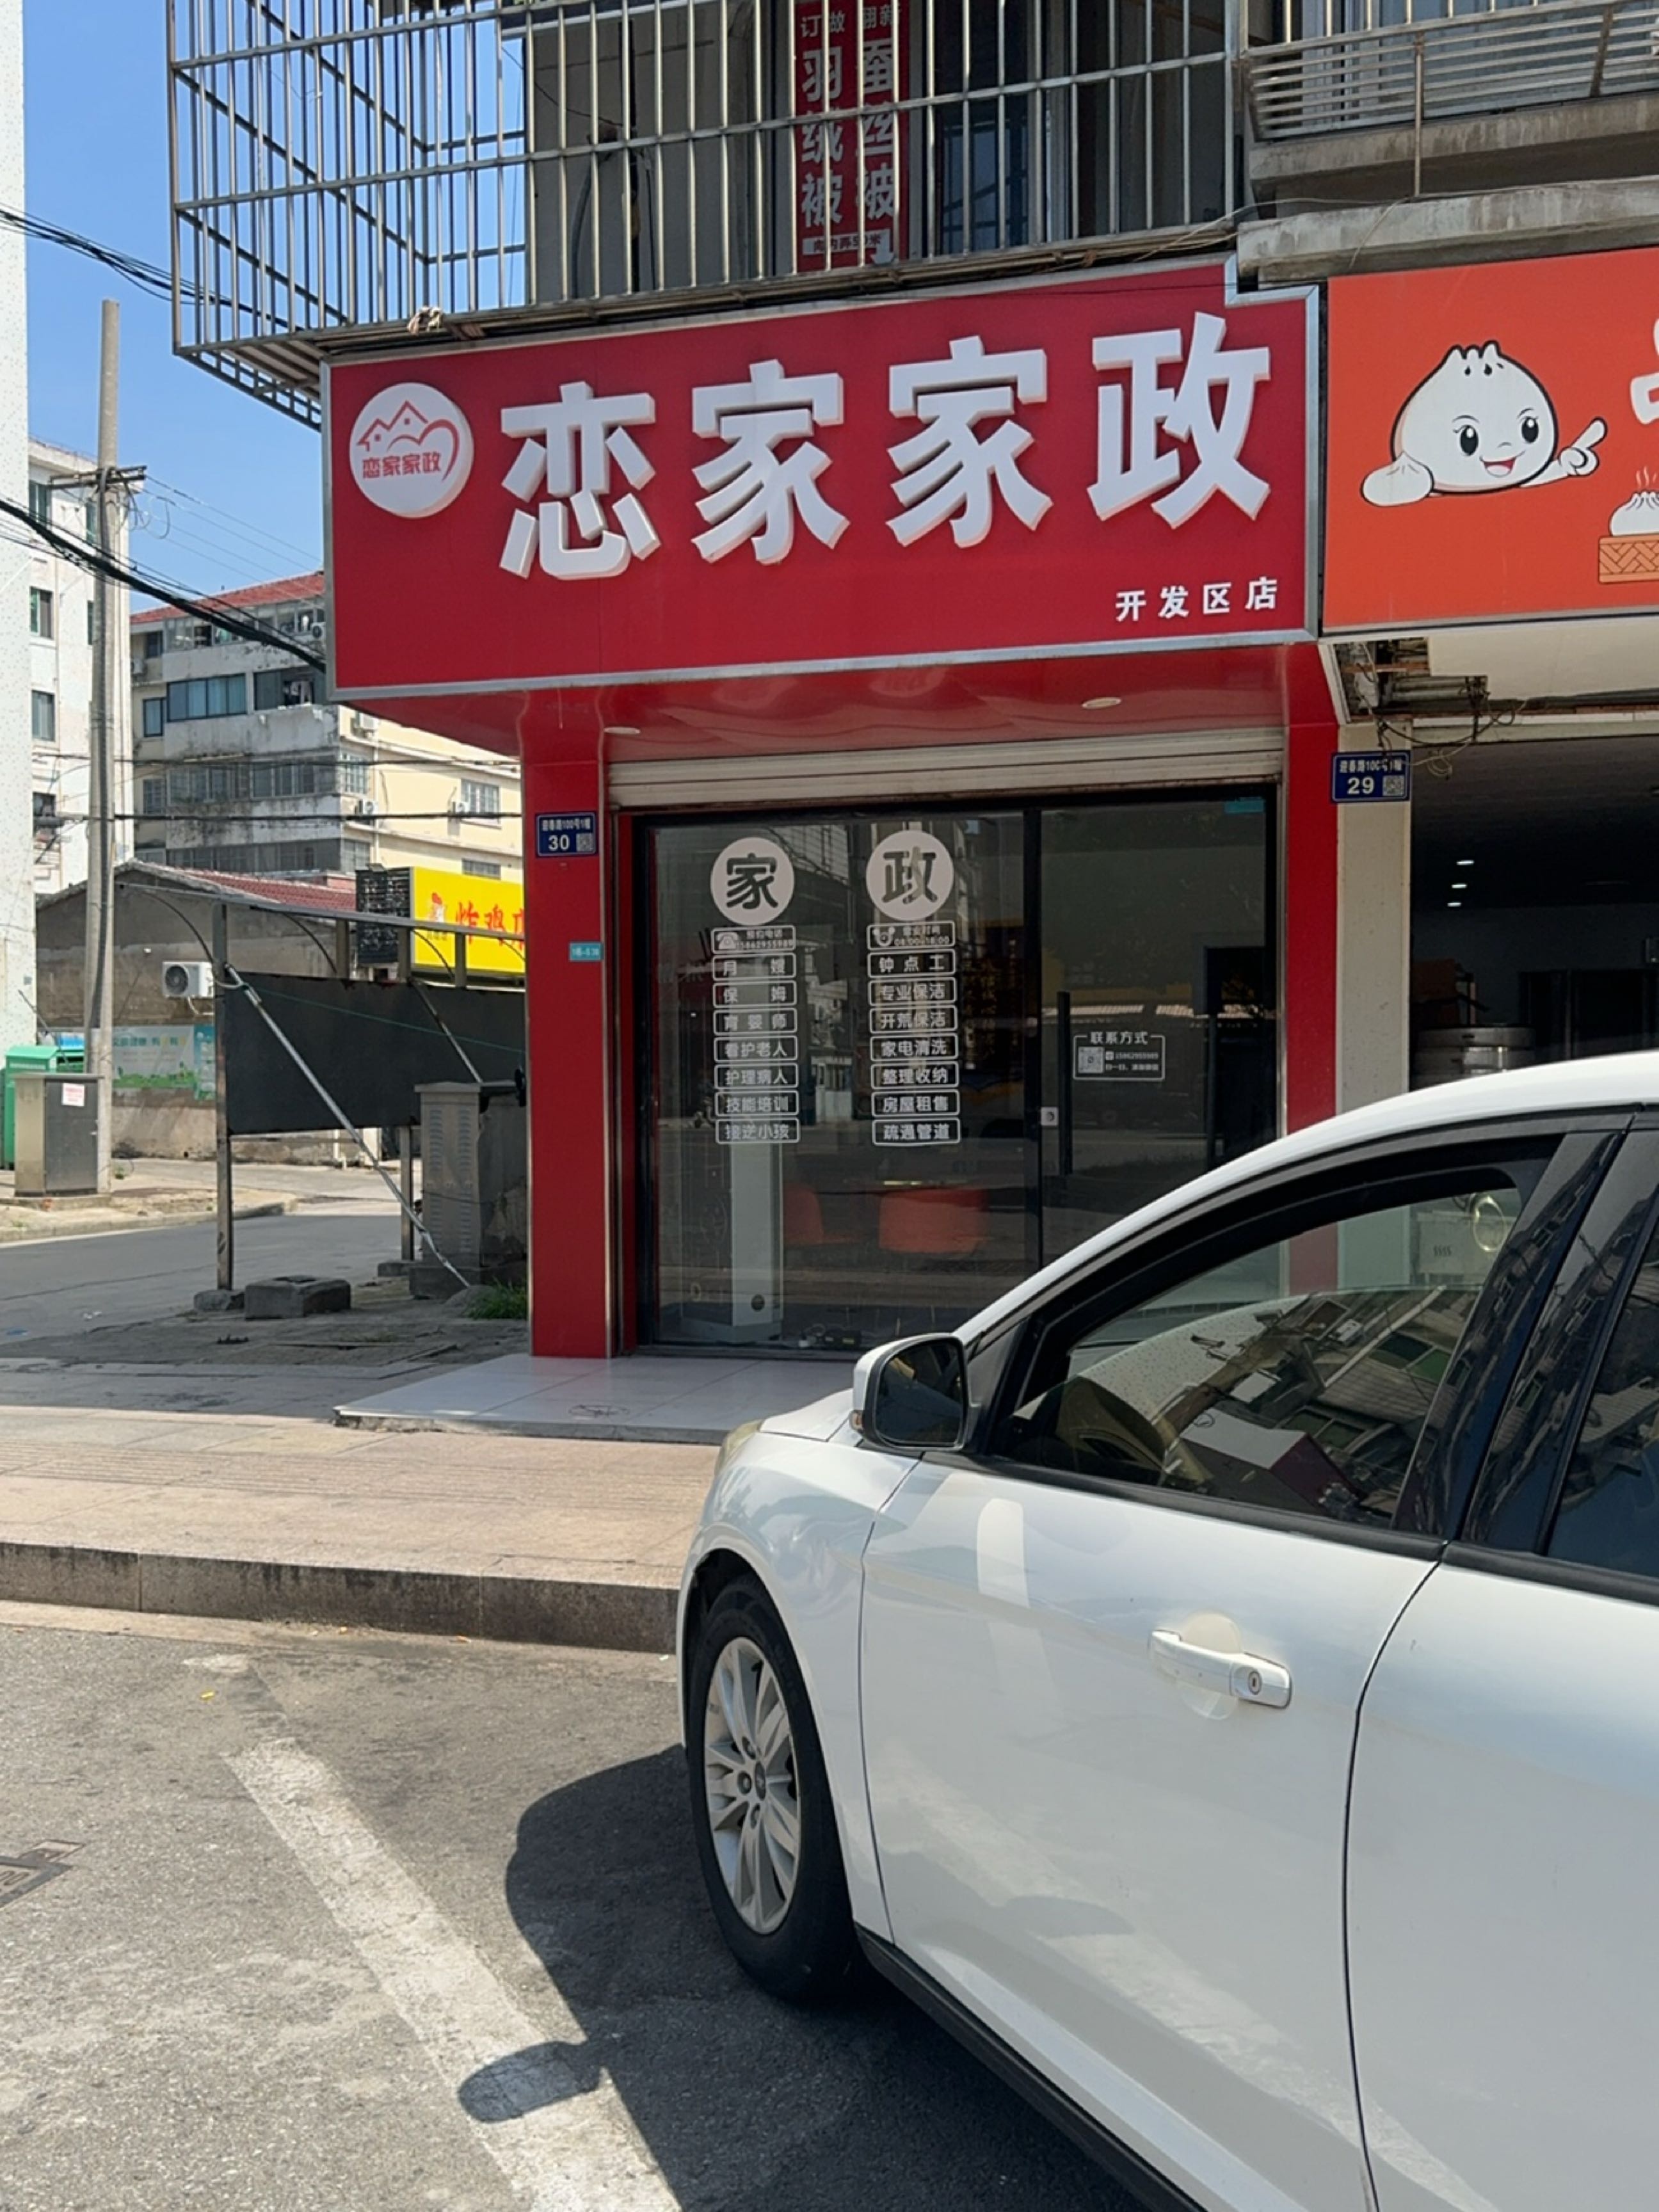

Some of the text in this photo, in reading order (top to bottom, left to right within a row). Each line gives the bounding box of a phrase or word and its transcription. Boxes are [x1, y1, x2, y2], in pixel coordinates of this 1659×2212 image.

[499, 311, 1272, 580] 恋家家政
[362, 451, 442, 479] 恋家家政
[1115, 576, 1278, 621] 开发区店
[1347, 777, 1375, 794] 29
[548, 835, 571, 851] 30
[726, 853, 779, 910] 家
[883, 846, 939, 904] 政
[879, 955, 945, 973] 钟点工
[880, 982, 945, 1002] 专业保洁
[881, 1009, 946, 1029] 开荒保洁
[725, 1040, 788, 1059] 看护老人
[881, 1038, 947, 1057] 家电清洗
[725, 1066, 789, 1086] 护理病人
[882, 1067, 947, 1085] 整理收纳
[726, 1096, 789, 1113] 技能培训
[883, 1094, 949, 1112] 房屋租售
